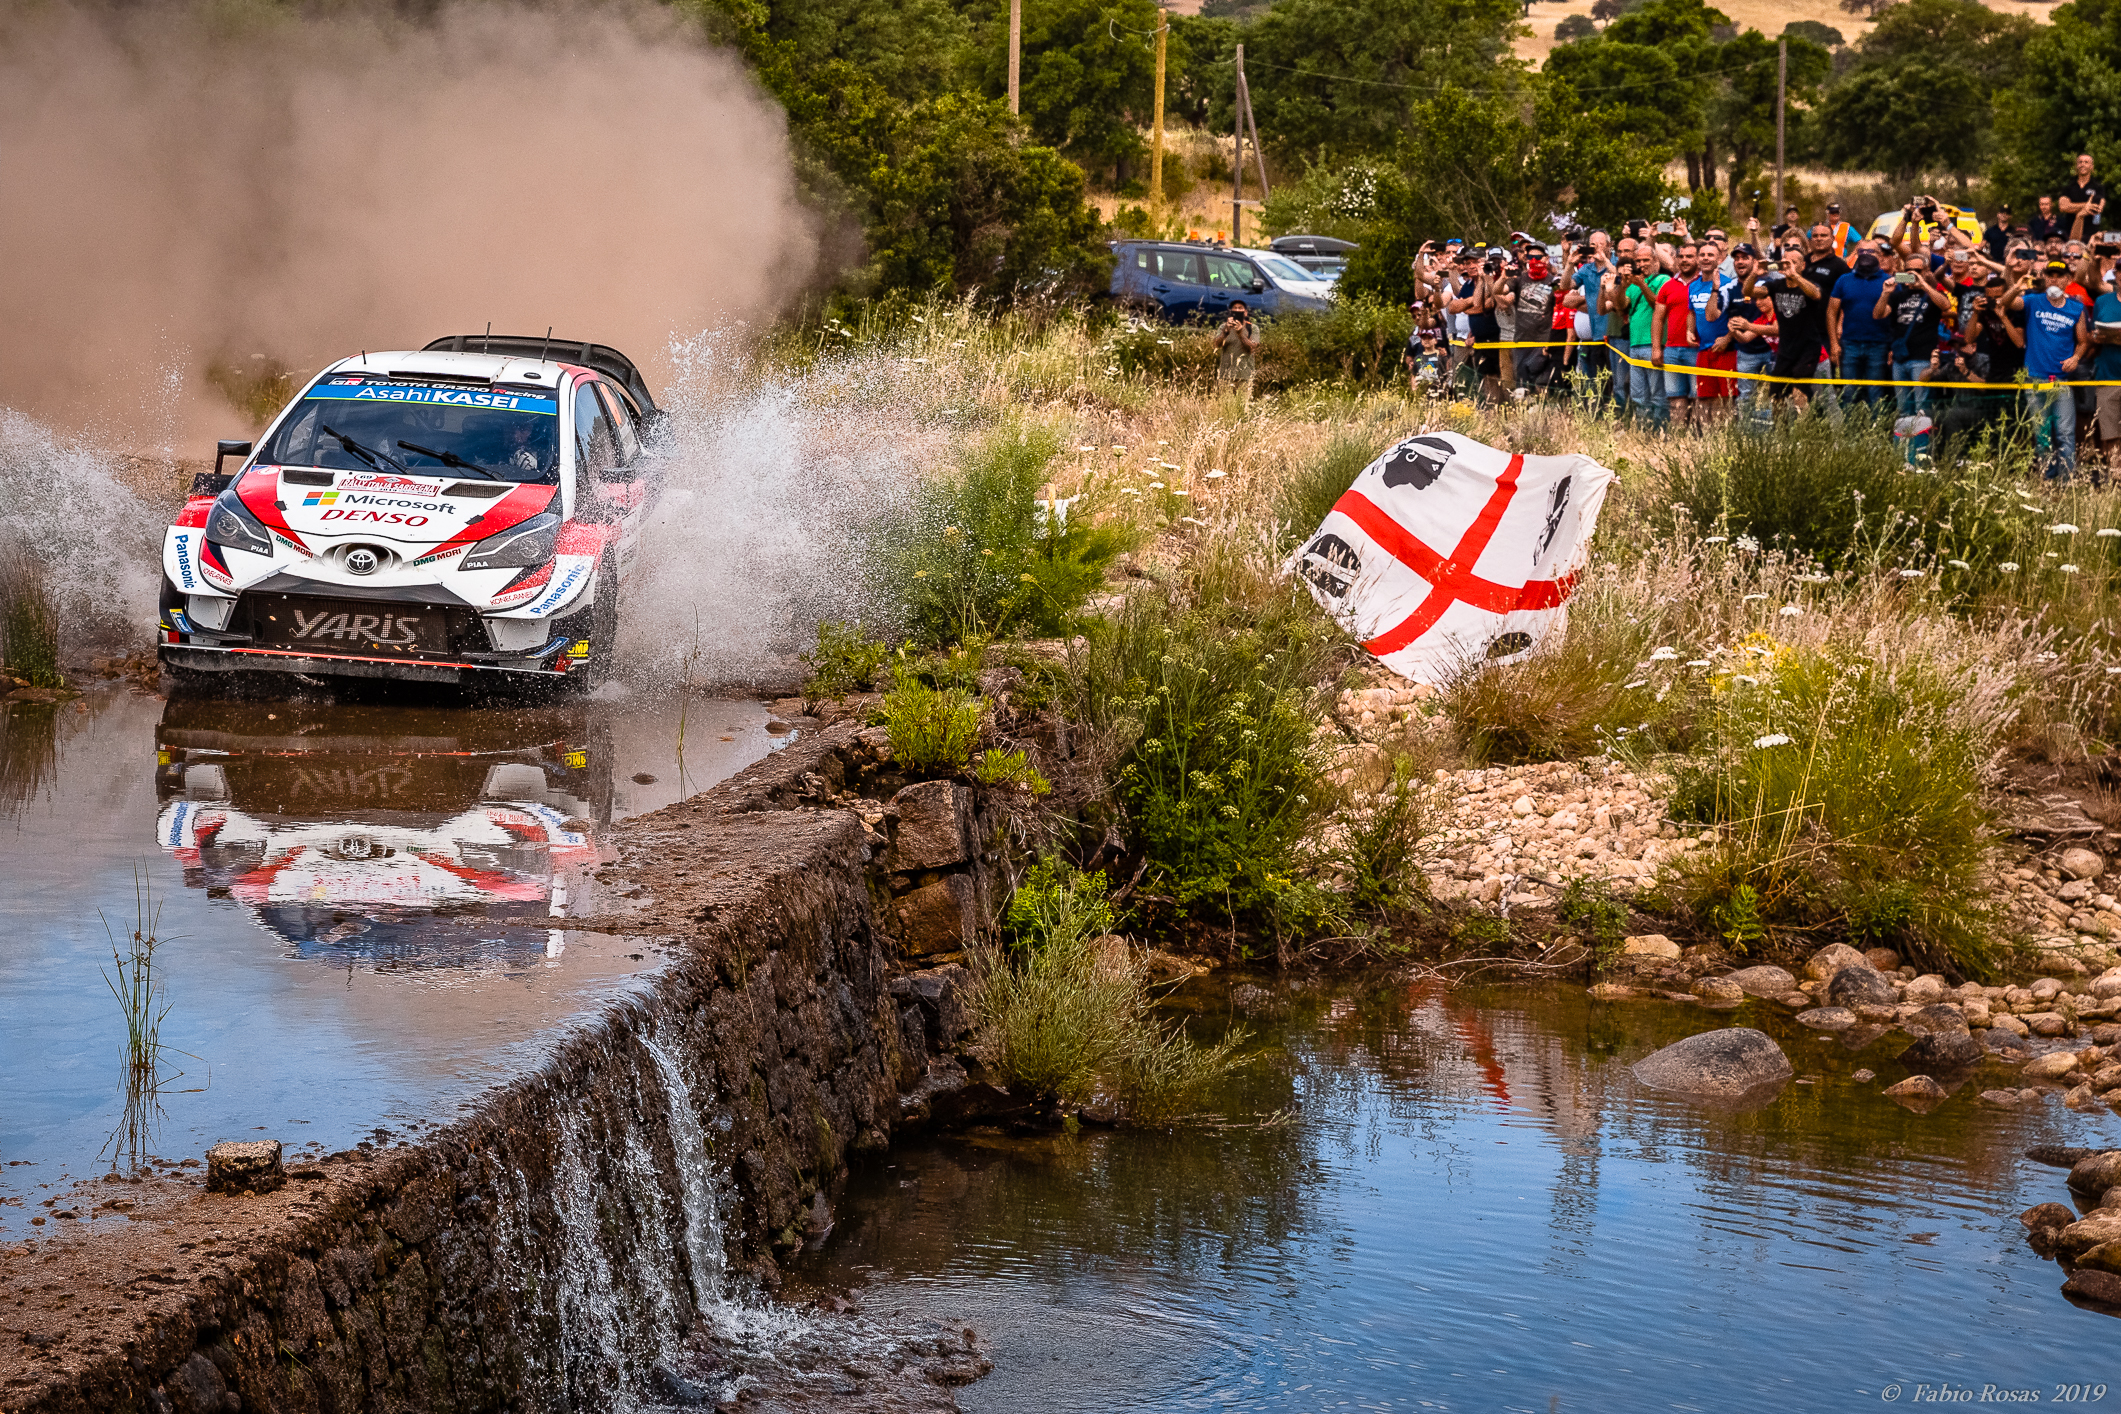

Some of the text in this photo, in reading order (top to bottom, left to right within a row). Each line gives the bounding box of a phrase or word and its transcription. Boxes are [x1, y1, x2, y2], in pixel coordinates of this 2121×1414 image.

[365, 380, 547, 400] TOYOTA GAZOO Racing
[343, 479, 368, 487] RALLY
[367, 481, 392, 489] ITALIA
[391, 483, 436, 493] SARDEGNA
[344, 494, 457, 514] Microsoft
[320, 509, 429, 527] DENSO
[250, 544, 269, 555] PIAA
[275, 534, 314, 559] DMG MORI
[175, 534, 198, 589] Panasonic
[413, 548, 462, 567] DMG MORI
[467, 561, 489, 569] PIAA
[530, 563, 585, 614] Panasonic
